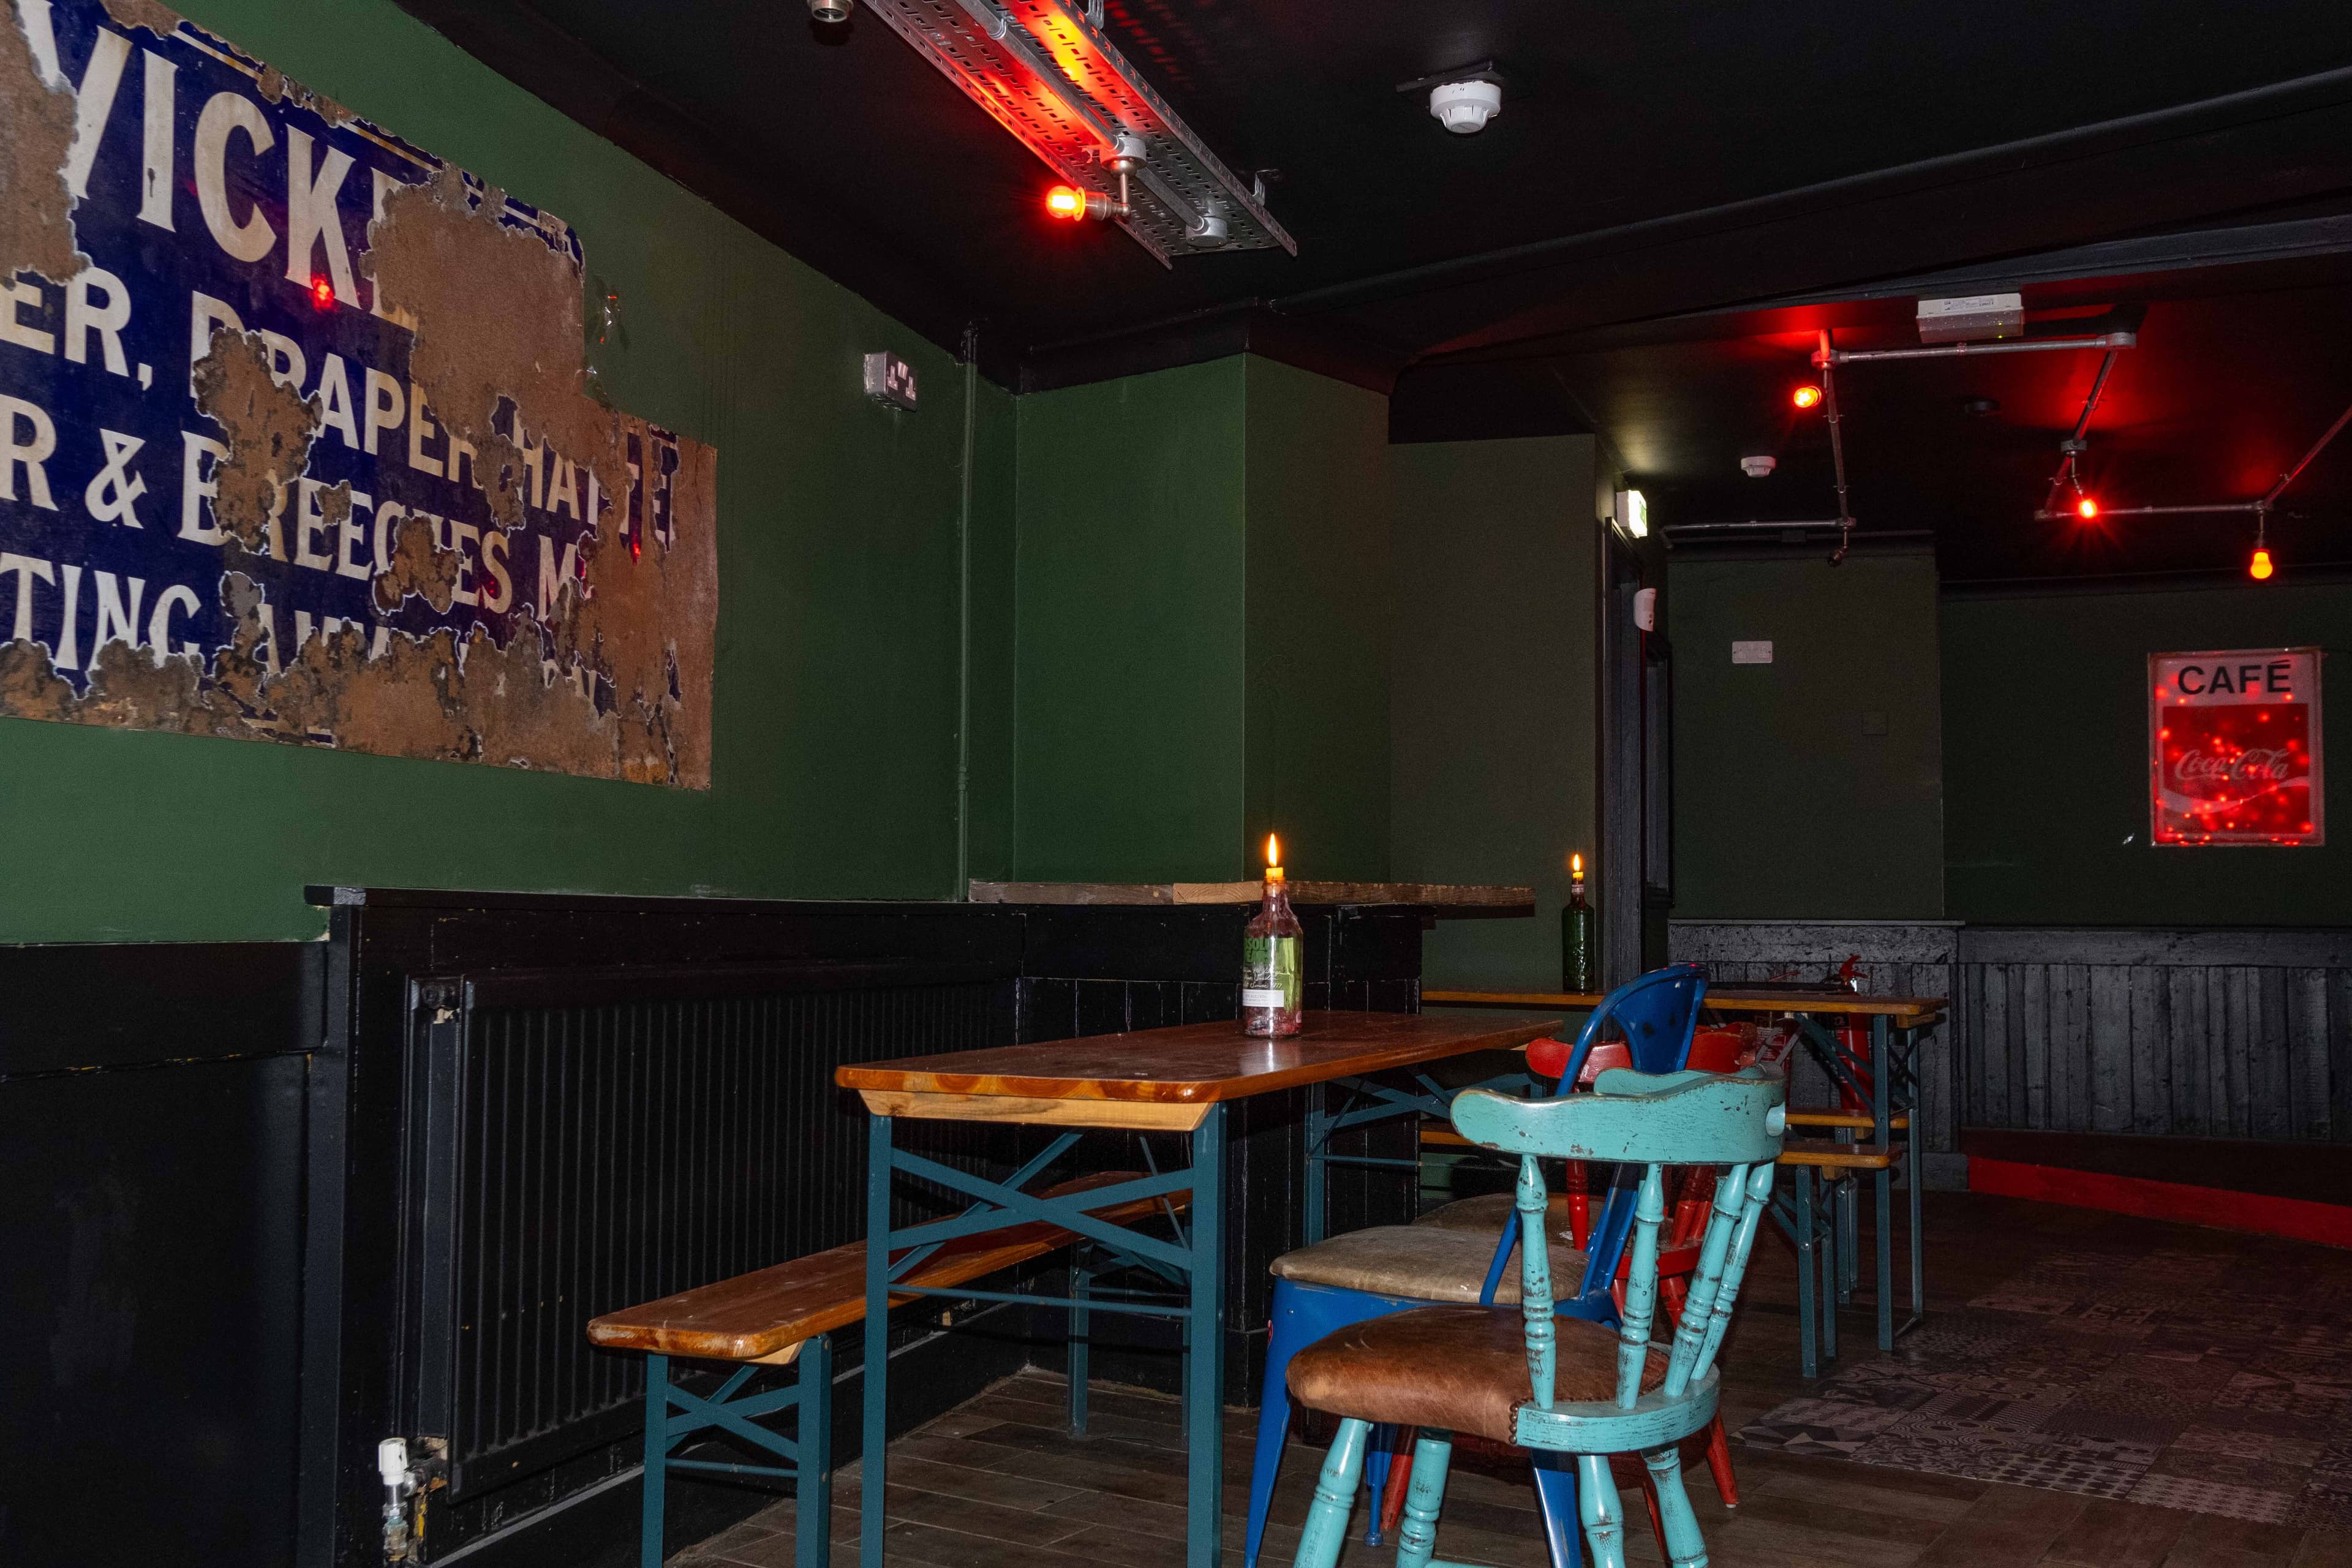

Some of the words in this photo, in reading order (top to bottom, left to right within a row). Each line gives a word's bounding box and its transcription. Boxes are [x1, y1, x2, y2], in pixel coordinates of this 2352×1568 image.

[85, 428, 148, 529] &
[177, 431, 512, 614] BEECES
[2177, 659, 2291, 695] CAFÉ
[2174, 748, 2291, 780] CocaCola
